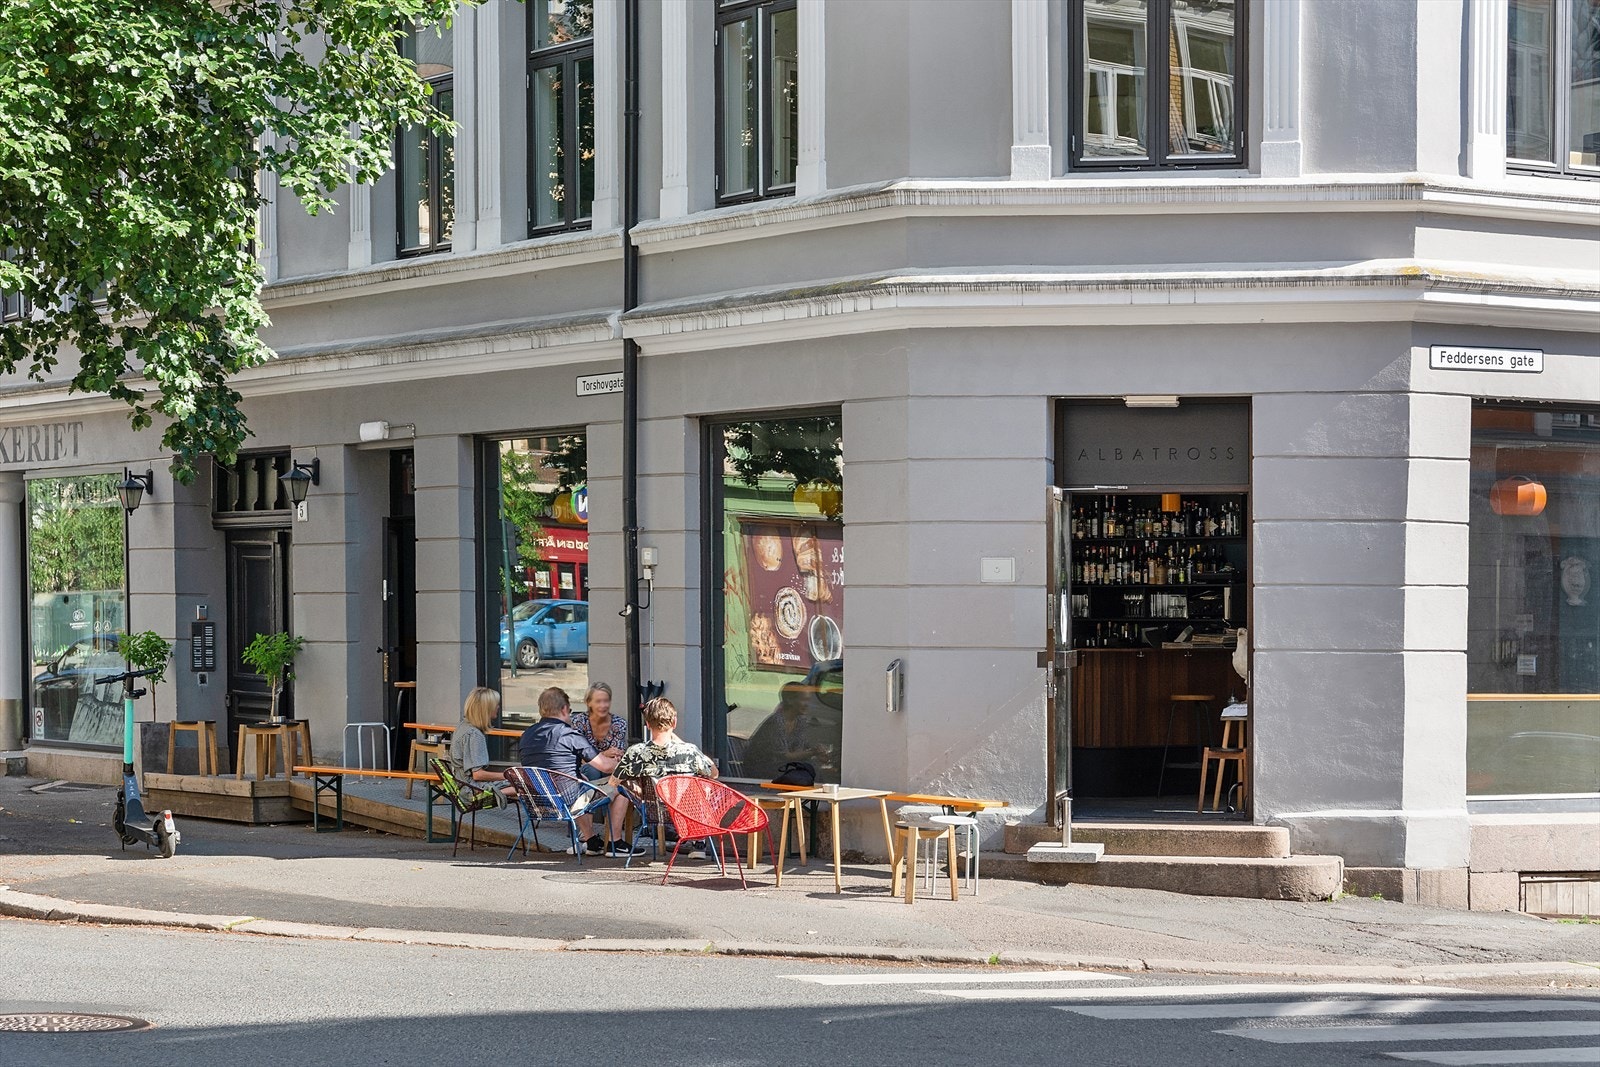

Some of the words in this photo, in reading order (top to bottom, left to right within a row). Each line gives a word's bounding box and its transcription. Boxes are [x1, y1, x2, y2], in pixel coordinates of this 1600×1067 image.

[1440, 351, 1504, 365] Feddersens
[1510, 355, 1535, 368] gate
[1077, 446, 1235, 461] ALBATROSS
